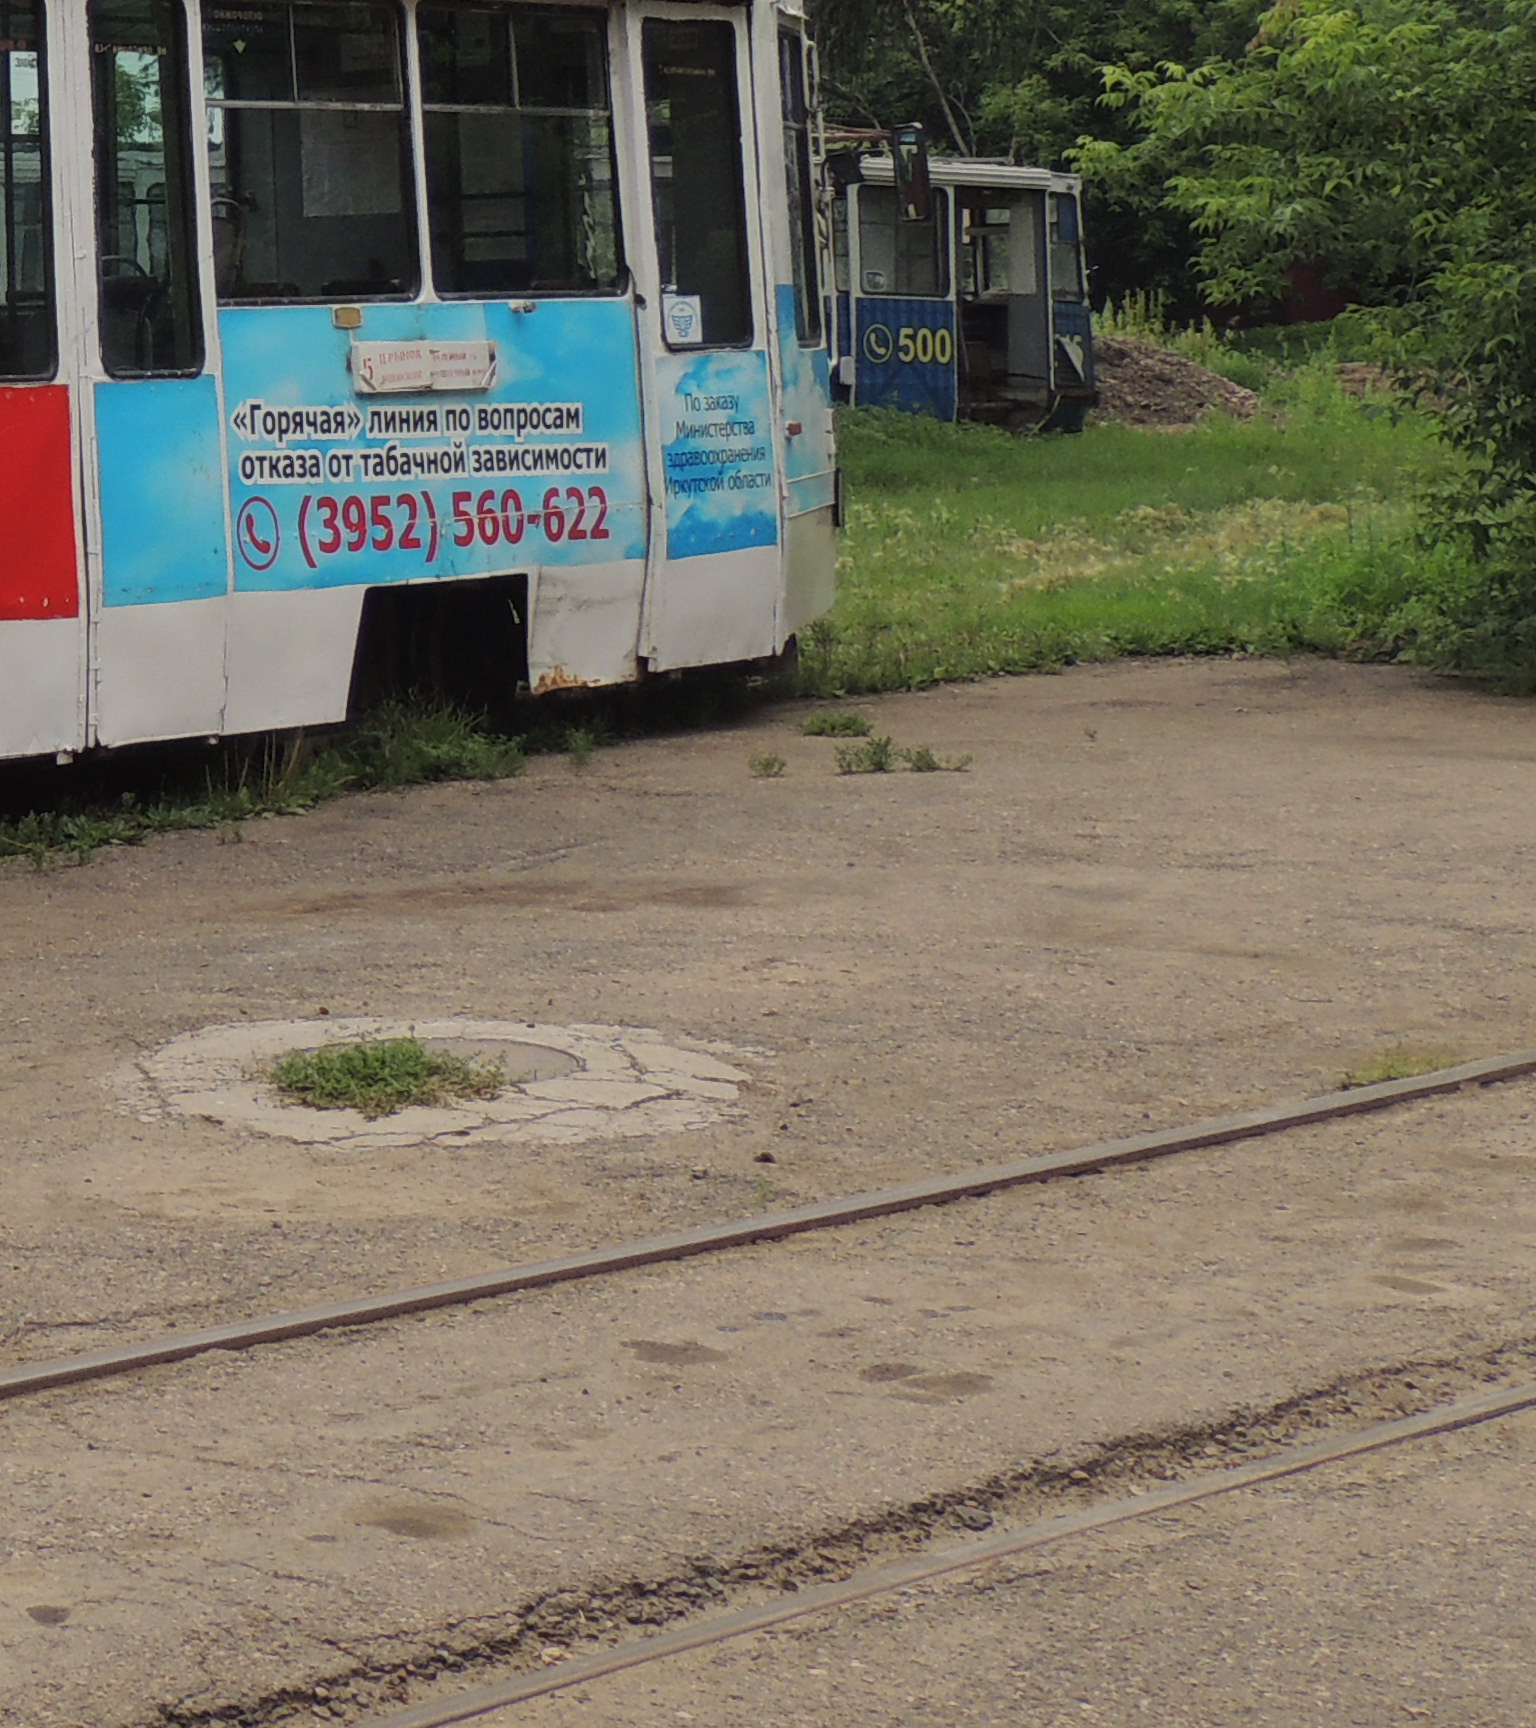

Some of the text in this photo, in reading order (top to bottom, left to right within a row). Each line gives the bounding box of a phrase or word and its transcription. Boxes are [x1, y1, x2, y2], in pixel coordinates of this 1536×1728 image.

[898, 327, 952, 364] 500
[684, 393, 740, 413] По заказу
[233, 404, 580, 442] «Горячая» линия по вопросам
[676, 421, 755, 442] Министерства
[241, 441, 607, 480] отказа от табачной зависимости
[667, 447, 766, 470] здравоохранения
[728, 470, 771, 491] области
[298, 486, 610, 569] (3952) 560-622
